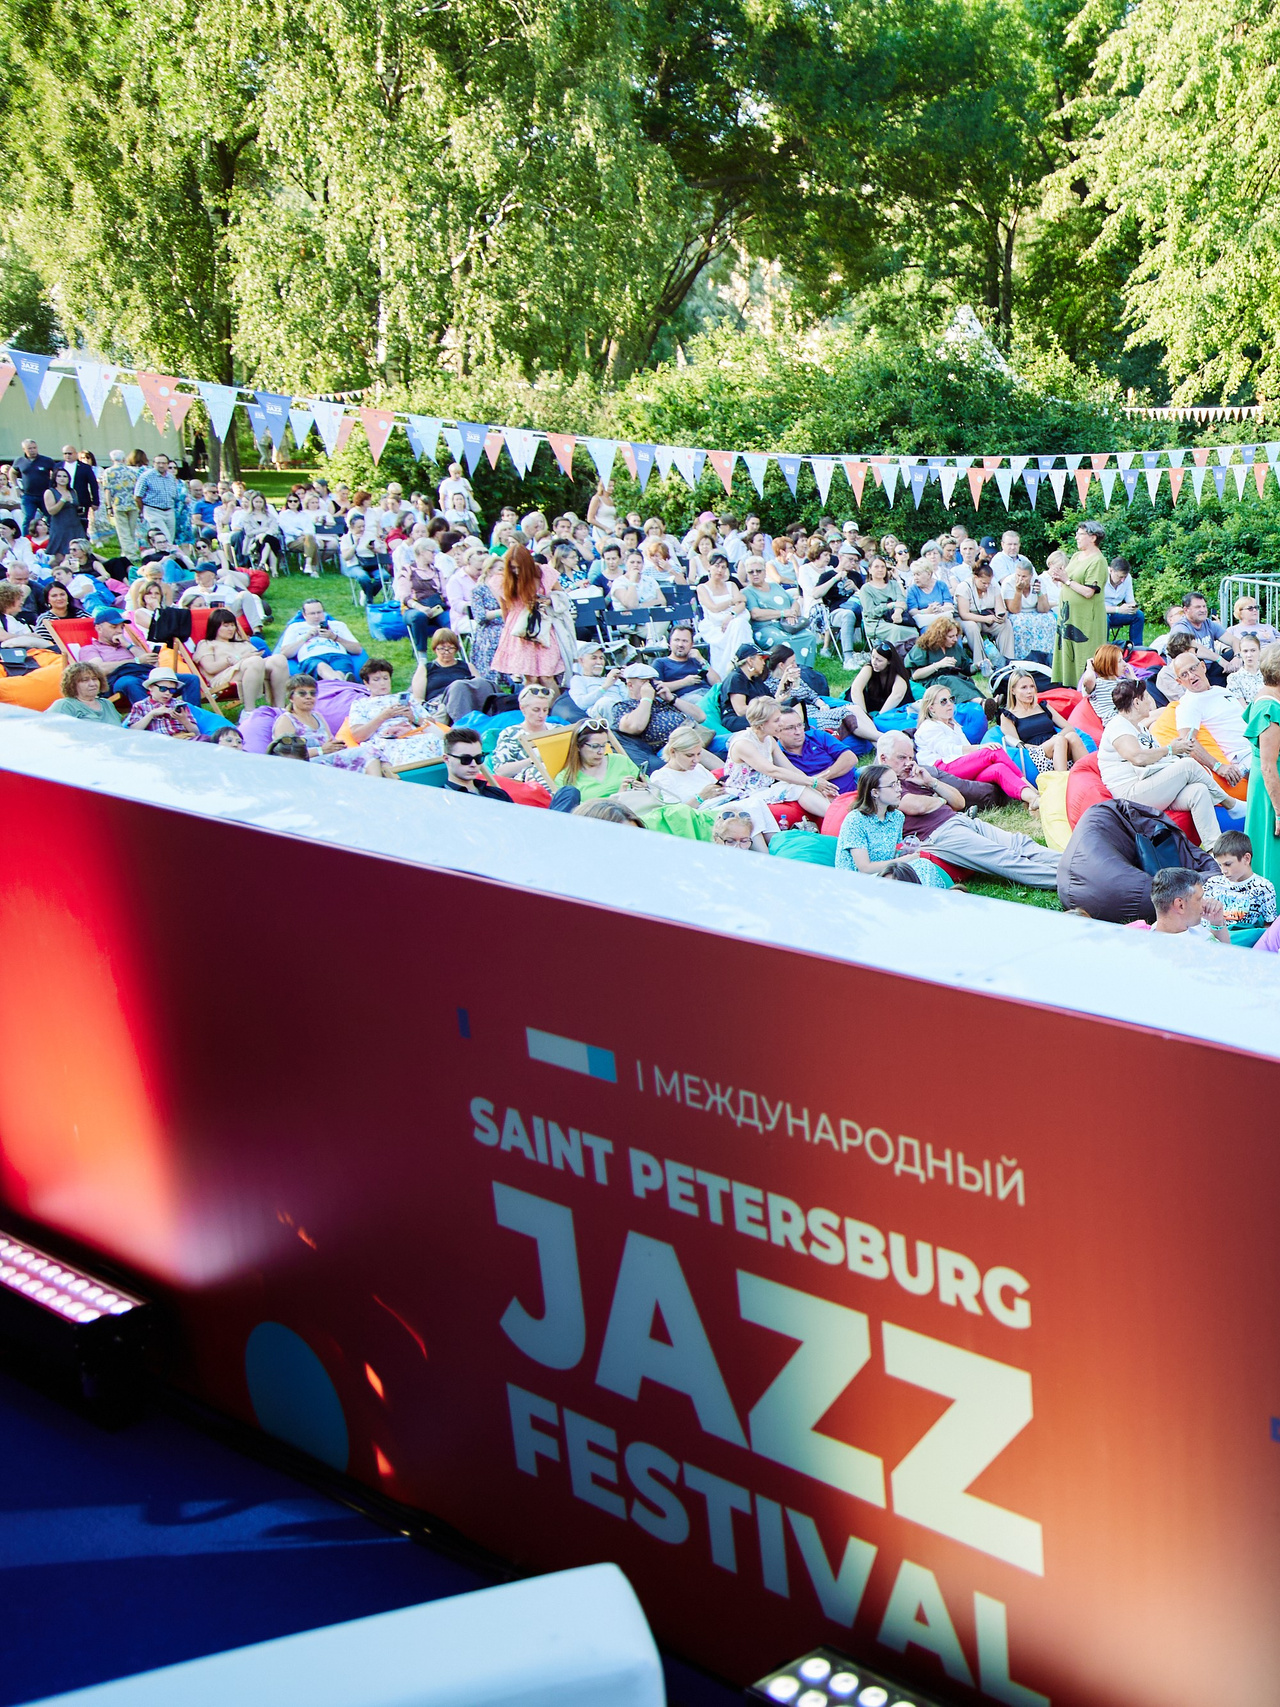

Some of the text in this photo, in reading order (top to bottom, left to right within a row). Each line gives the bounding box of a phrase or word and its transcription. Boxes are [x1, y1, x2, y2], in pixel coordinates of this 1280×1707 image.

[469, 1096, 1032, 1330] SAINT PETERSBURG
[636, 1060, 1026, 1207] I МЕЖДУНАРОДНЫЙ
[492, 1180, 1045, 1578] JAZZ
[506, 1382, 1052, 1707] FESTIVAL
